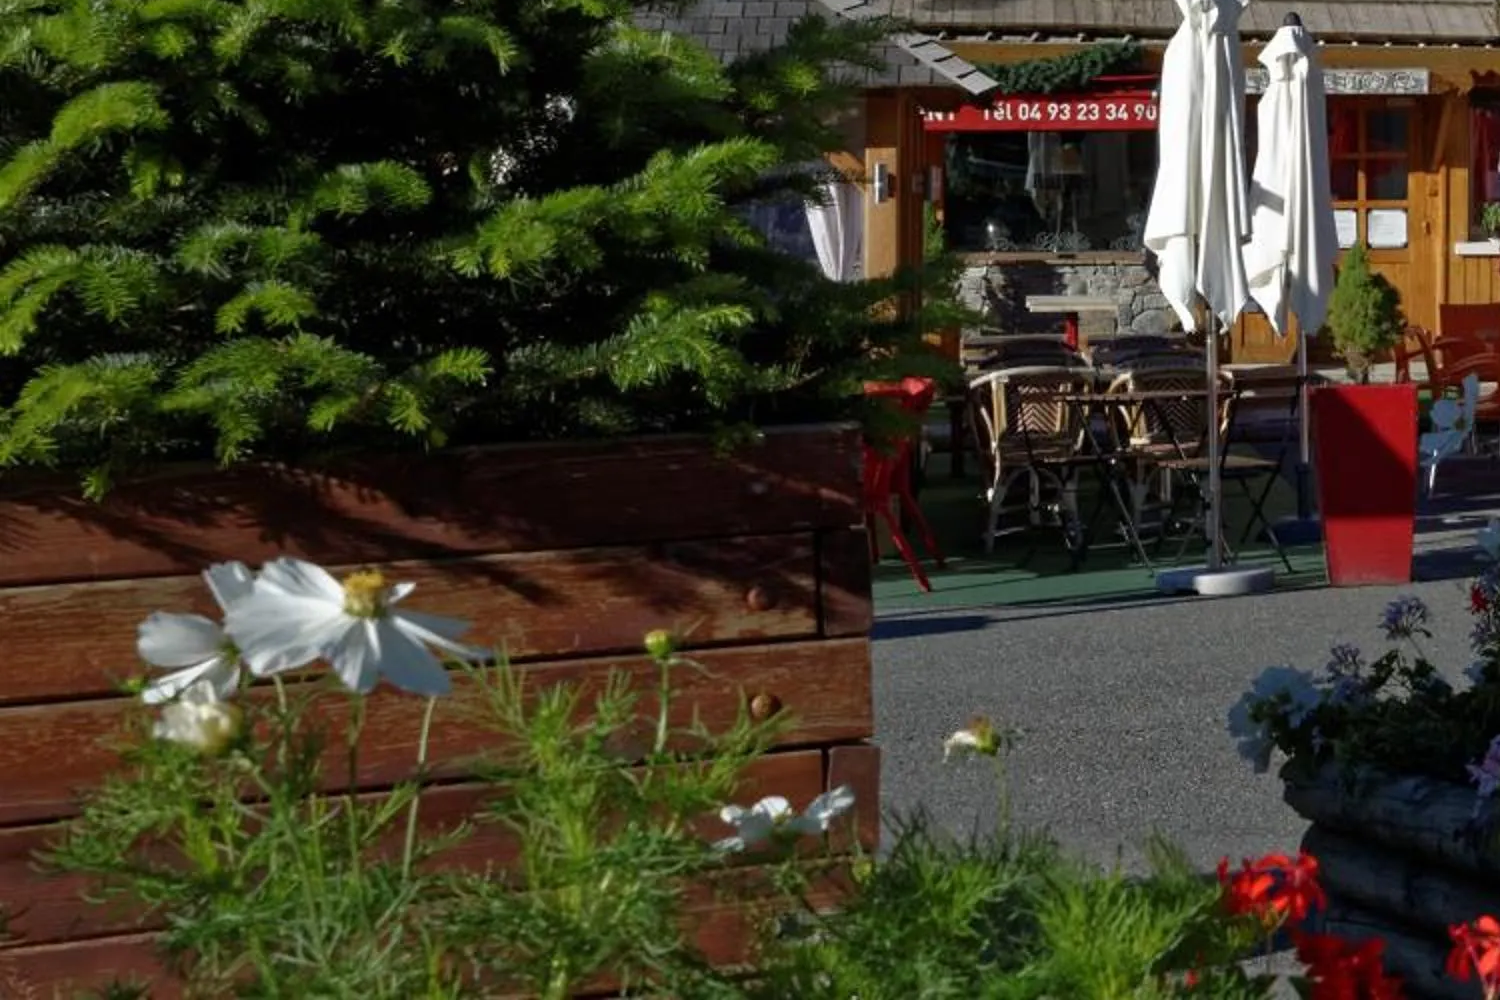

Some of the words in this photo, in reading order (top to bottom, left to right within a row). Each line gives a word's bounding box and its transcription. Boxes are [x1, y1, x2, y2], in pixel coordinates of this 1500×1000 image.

[1018, 103, 1042, 121] 04
[1047, 103, 1071, 121] 93
[1076, 103, 1100, 121] 23
[1105, 103, 1129, 121] 34
